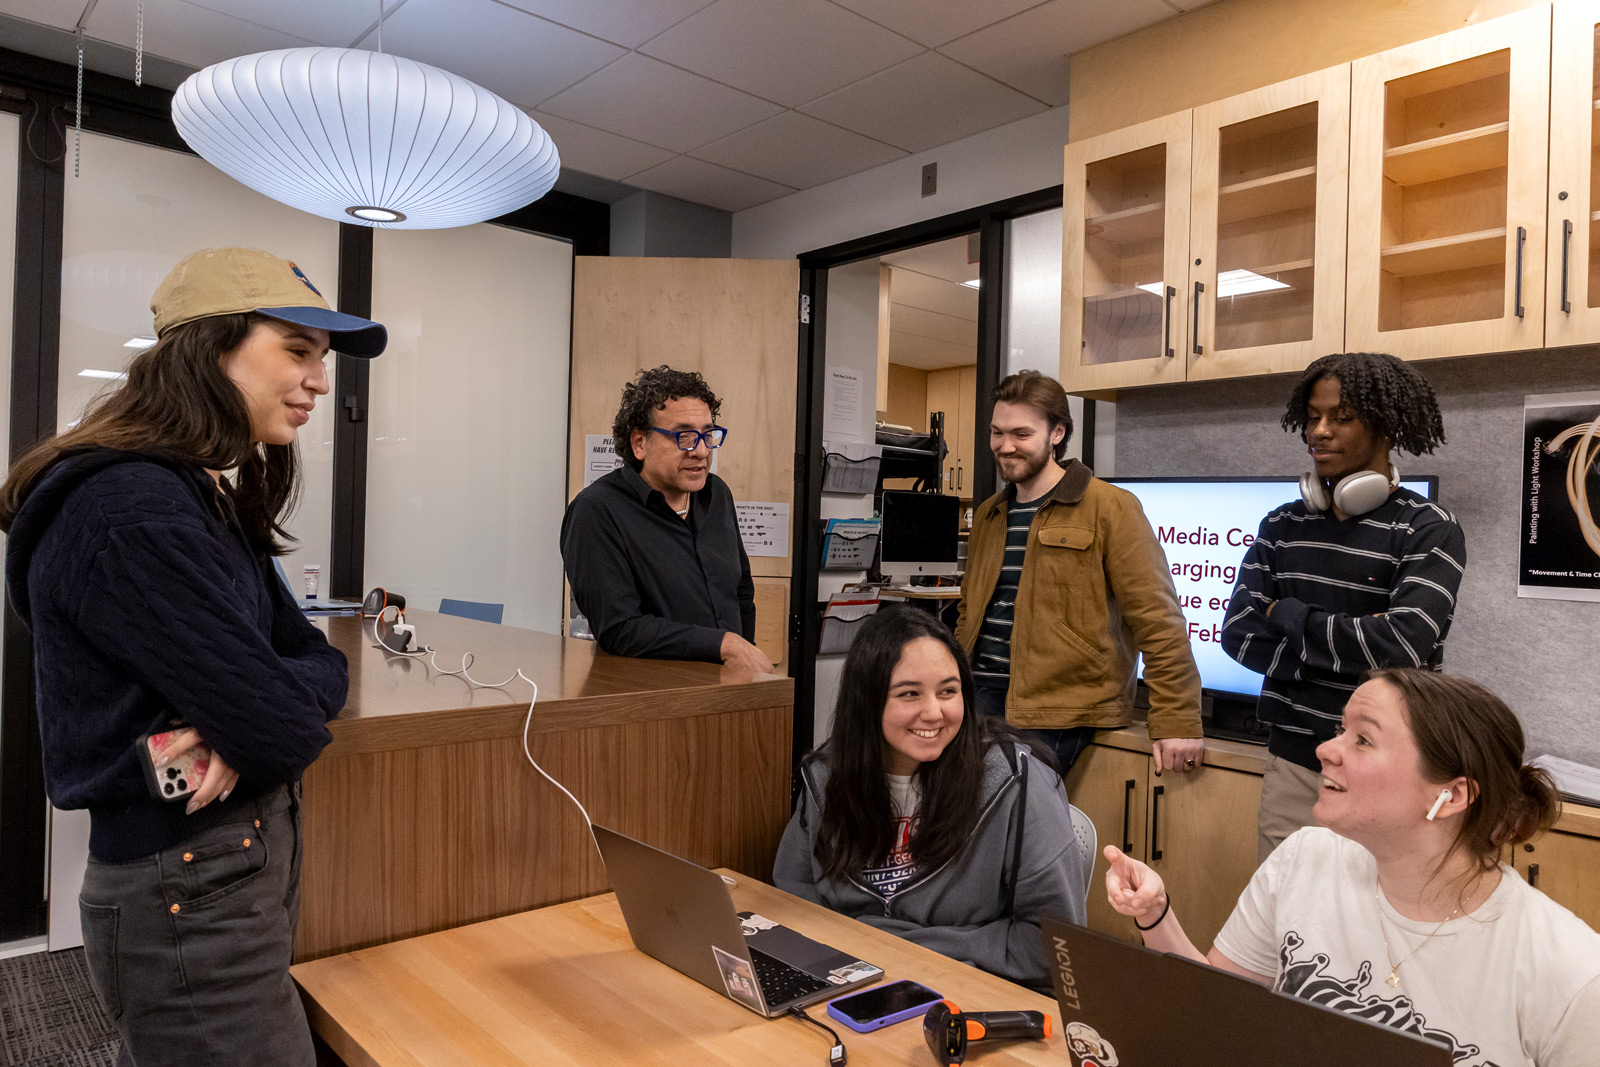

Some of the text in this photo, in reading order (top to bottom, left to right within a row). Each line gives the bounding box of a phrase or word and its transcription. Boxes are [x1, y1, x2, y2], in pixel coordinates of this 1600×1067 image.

[592, 446, 607, 454] HAVE
[1529, 436, 1543, 544] Painting with Light Workshop
[1158, 526, 1255, 547] Media Ce
[1171, 559, 1236, 584] arging
[1187, 622, 1222, 644] Feb
[1052, 936, 1081, 1011] LEGION
